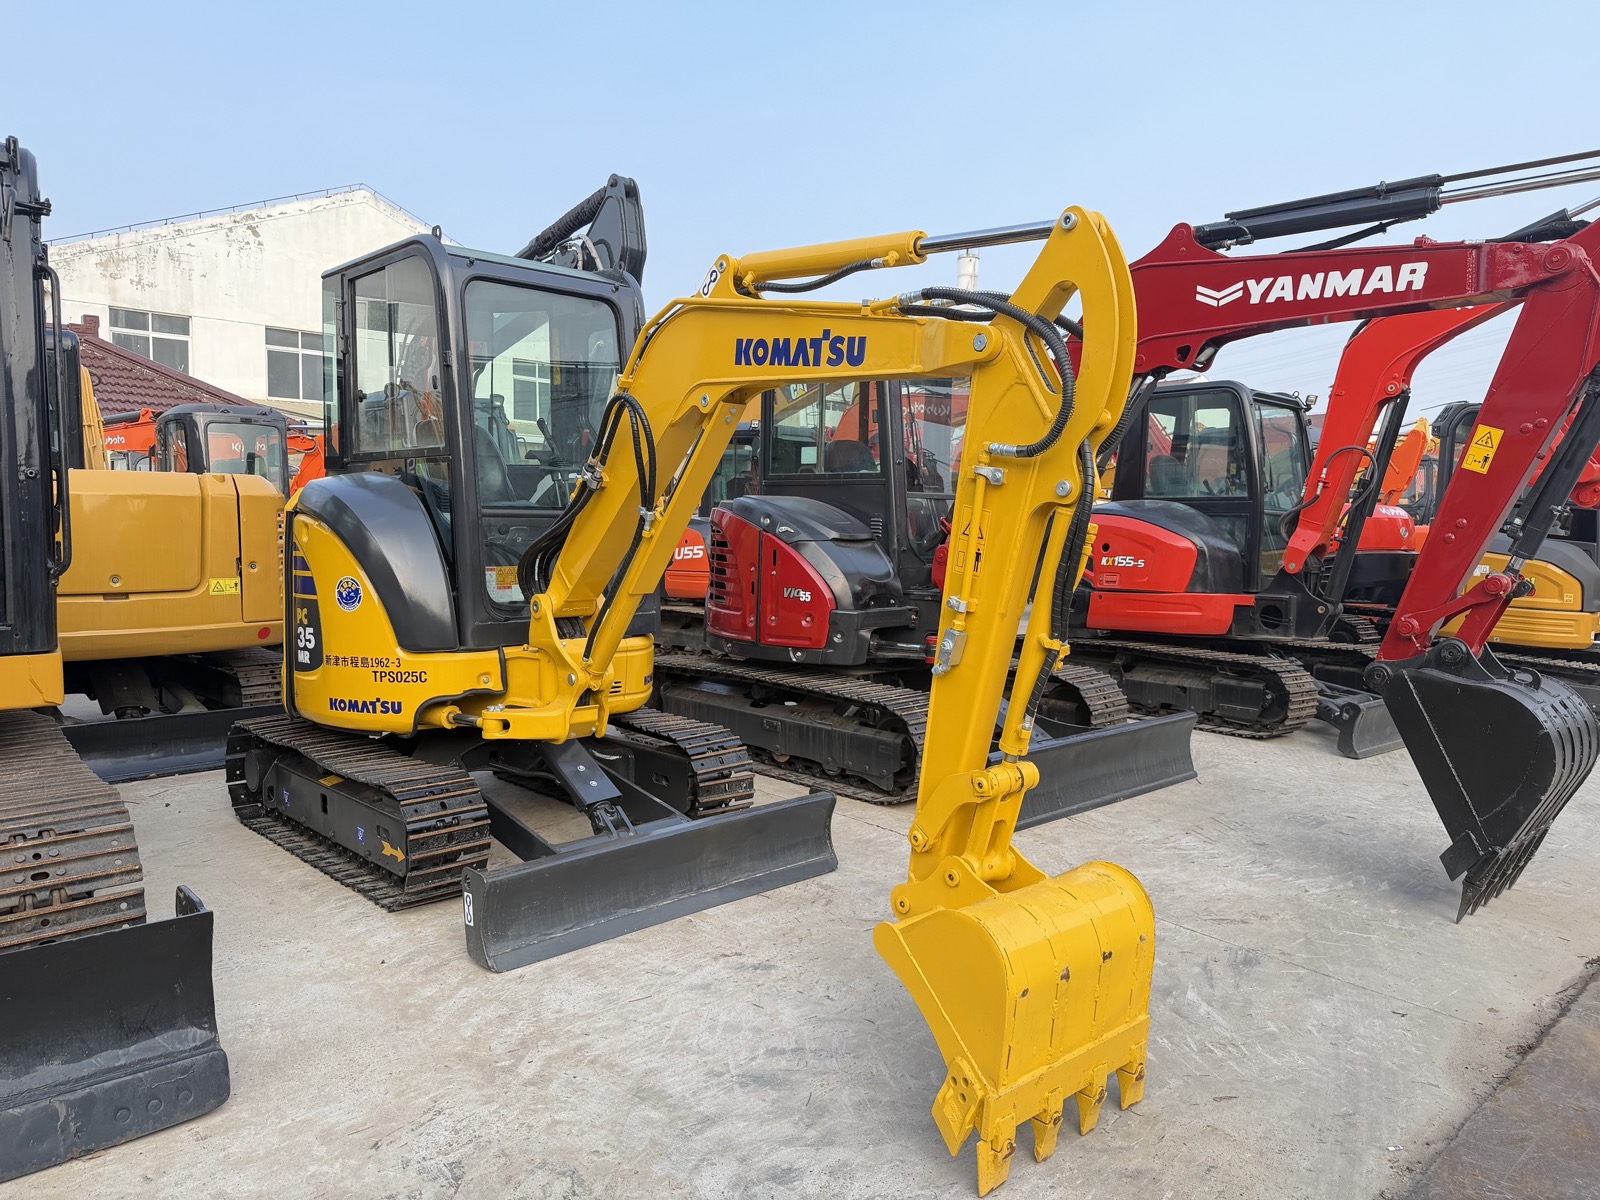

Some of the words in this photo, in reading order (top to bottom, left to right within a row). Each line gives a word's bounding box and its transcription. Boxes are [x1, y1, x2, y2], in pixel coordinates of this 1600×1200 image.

[1246, 261, 1429, 305] YANMAR
[735, 329, 867, 367] KOMATSU
[103, 434, 126, 445] ubota
[231, 441, 266, 453] Kuta
[1100, 555, 1145, 568] KX155-5
[296, 607, 308, 625] PC
[297, 626, 316, 650] 35
[297, 649, 311, 664] MR
[372, 670, 428, 684] TPS025C
[329, 697, 403, 715] KOMATSU
